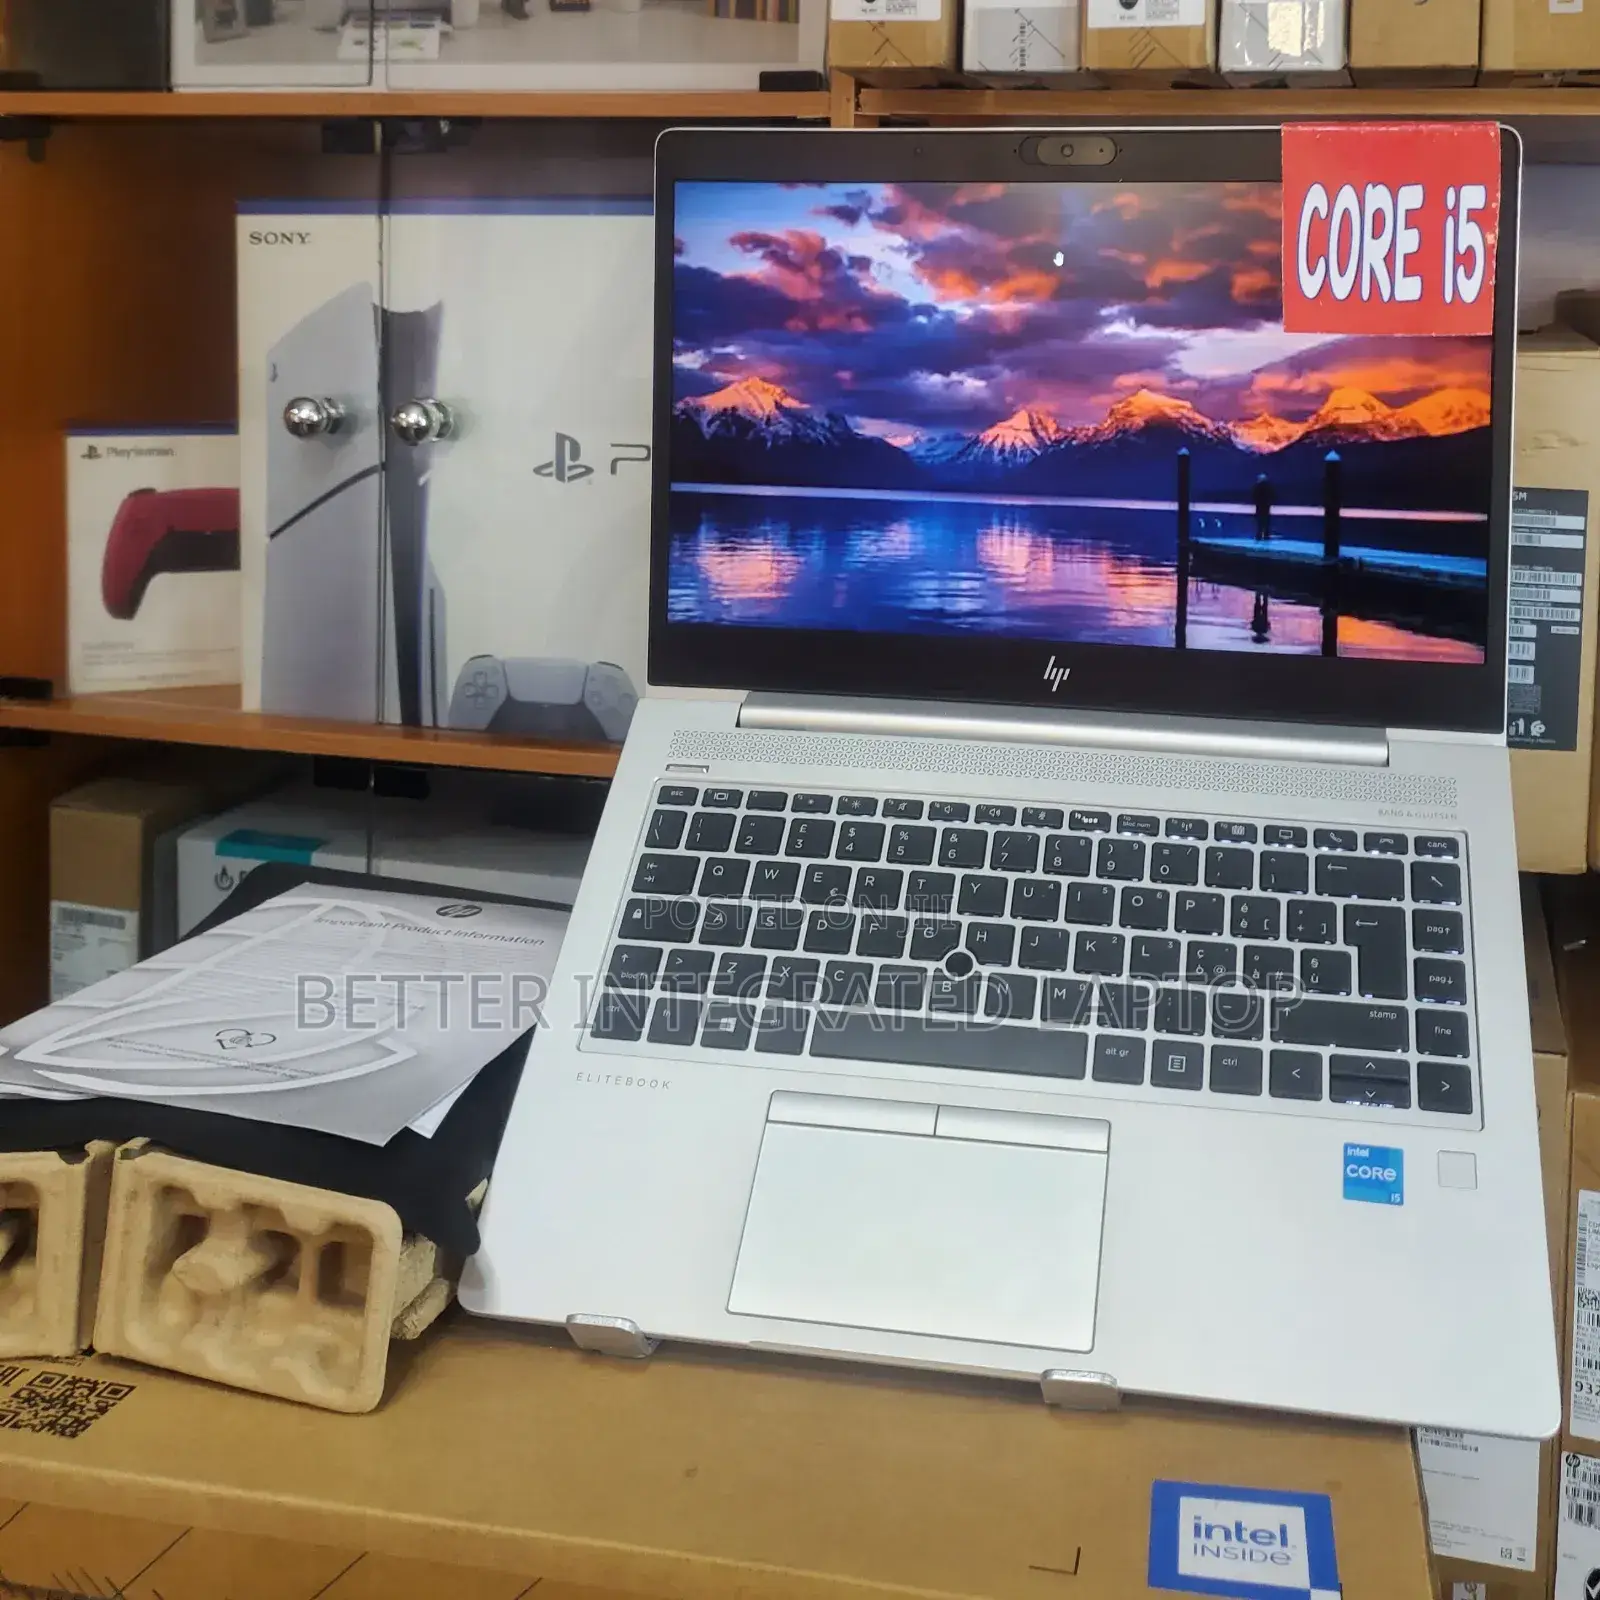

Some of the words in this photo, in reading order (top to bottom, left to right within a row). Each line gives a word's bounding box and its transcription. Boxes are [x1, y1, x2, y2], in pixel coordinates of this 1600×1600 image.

[249, 231, 311, 246] SONY
[1297, 182, 1425, 303] CORE
[1443, 184, 1487, 304] i5
[1043, 655, 1070, 692] hp
[670, 789, 684, 797] esc
[799, 824, 808, 833] £
[848, 828, 856, 838] $
[744, 836, 753, 846] 2
[899, 831, 909, 841] %
[949, 833, 958, 843] &
[794, 839, 804, 849] 3
[845, 842, 854, 852] 4
[1427, 841, 1447, 849] canc
[896, 846, 905, 856] 5
[948, 849, 957, 859] 6
[1000, 852, 1009, 862] 7
[1054, 857, 1062, 867] 8
[712, 865, 724, 876] Q
[1107, 861, 1115, 871] 9
[764, 869, 779, 880] W
[813, 871, 823, 882] E
[864, 876, 875, 887] R
[917, 879, 926, 890] T
[970, 882, 982, 893] Y
[1023, 887, 1034, 898] U
[1132, 895, 1144, 906] O
[1185, 900, 1196, 911] P
[765, 916, 775, 926] S
[817, 920, 828, 931] D
[313, 916, 391, 930] Important
[391, 922, 452, 936] Product
[452, 929, 545, 946] Information
[869, 923, 880, 933] F
[923, 927, 935, 938] G
[1427, 925, 1444, 934] pag
[976, 931, 987, 942] H
[1030, 936, 1039, 947] J
[1086, 940, 1096, 952] K
[1141, 945, 1150, 956] L
[726, 962, 737, 973] Z
[779, 966, 791, 977] X
[1213, 964, 1226, 976] @
[834, 970, 845, 981] C
[1429, 974, 1446, 984] pag
[941, 981, 952, 992] B
[996, 983, 1008, 994] N
[1053, 988, 1066, 999] M
[1369, 1010, 1397, 1020] stamp
[1434, 1026, 1452, 1035] fine
[1222, 1057, 1238, 1066] ctrl
[576, 1072, 671, 1090] ELITEBOOK
[1347, 1147, 1369, 1158] intel
[1193, 1515, 1289, 1548] intel
